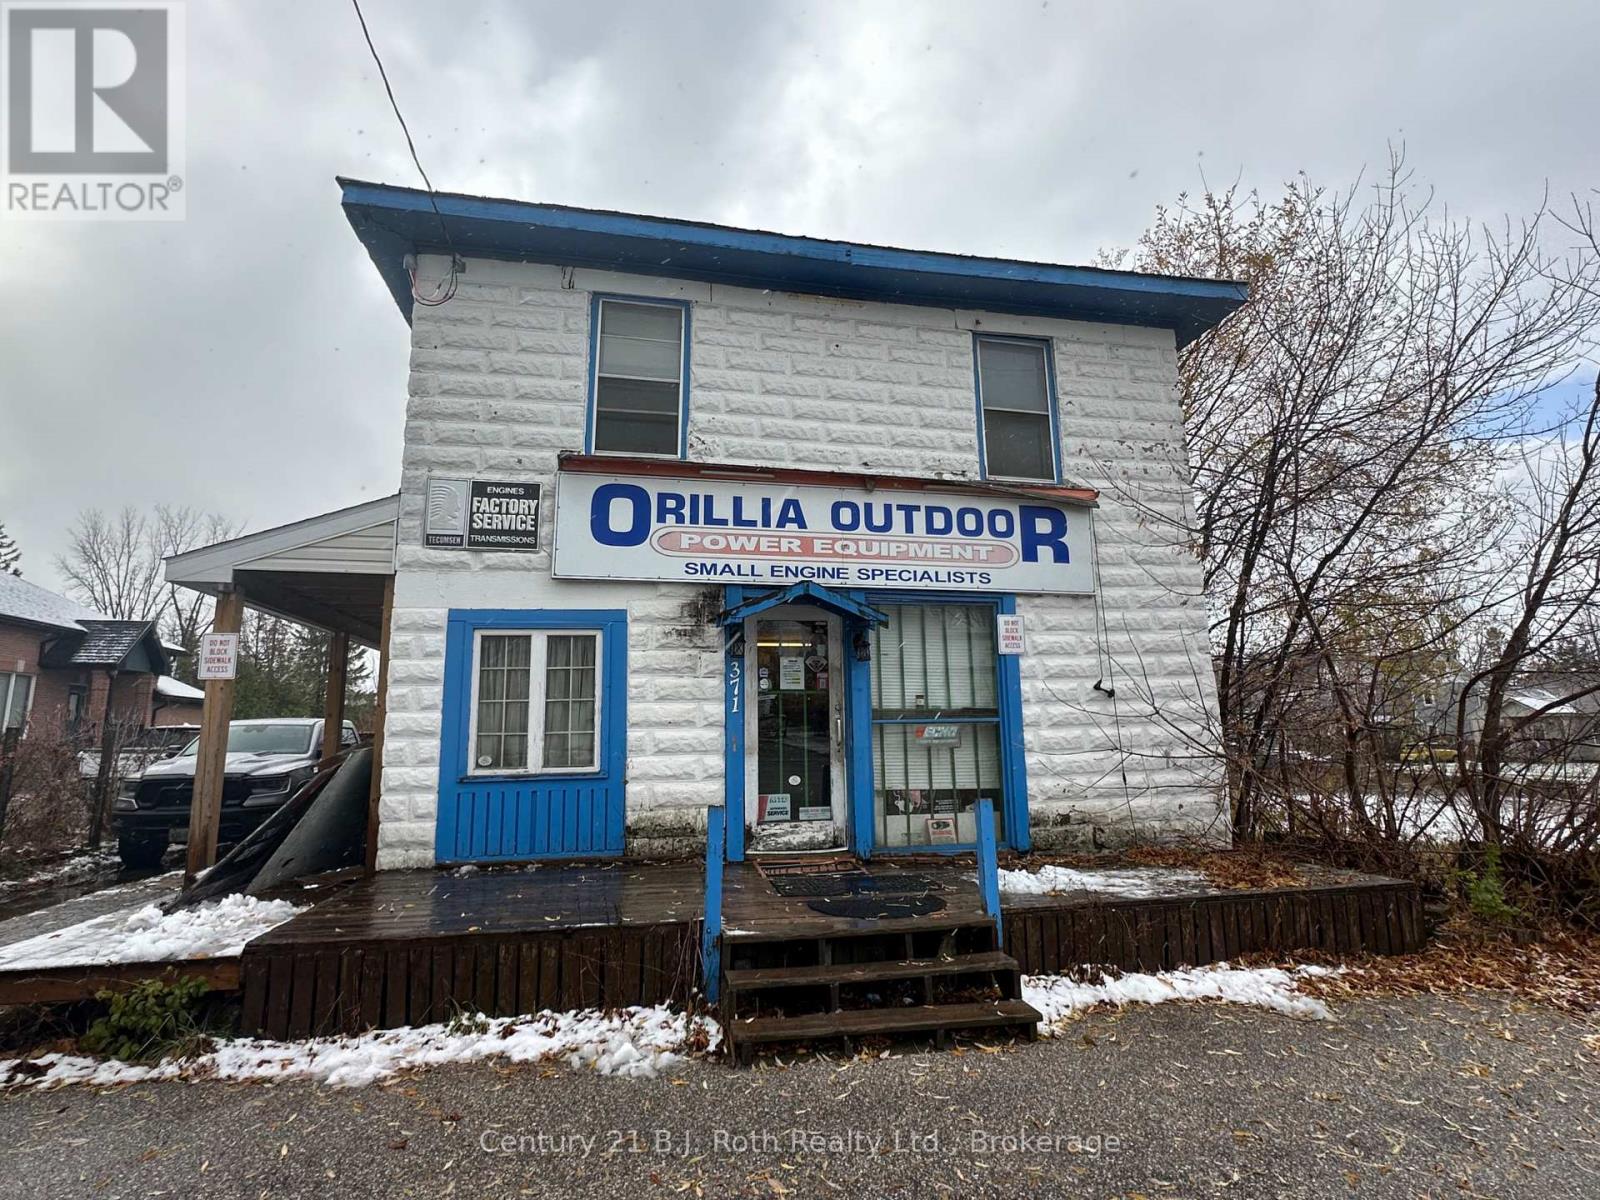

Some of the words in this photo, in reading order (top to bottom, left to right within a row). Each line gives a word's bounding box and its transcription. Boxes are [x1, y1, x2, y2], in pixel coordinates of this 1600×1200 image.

[487, 486, 525, 495] ENGINES
[472, 497, 538, 515] FACTORY
[472, 513, 536, 531] SERVICE
[590, 483, 808, 547] ORILLIA
[831, 500, 1070, 564] OUTDOOR
[470, 534, 536, 544] TRANSMISSIONS
[680, 533, 802, 553] POWER
[813, 538, 995, 561] EQUIPMENT
[684, 562, 763, 577] SMALL
[770, 565, 850, 579] ENGINE
[857, 568, 992, 584] SPECIALISTS
